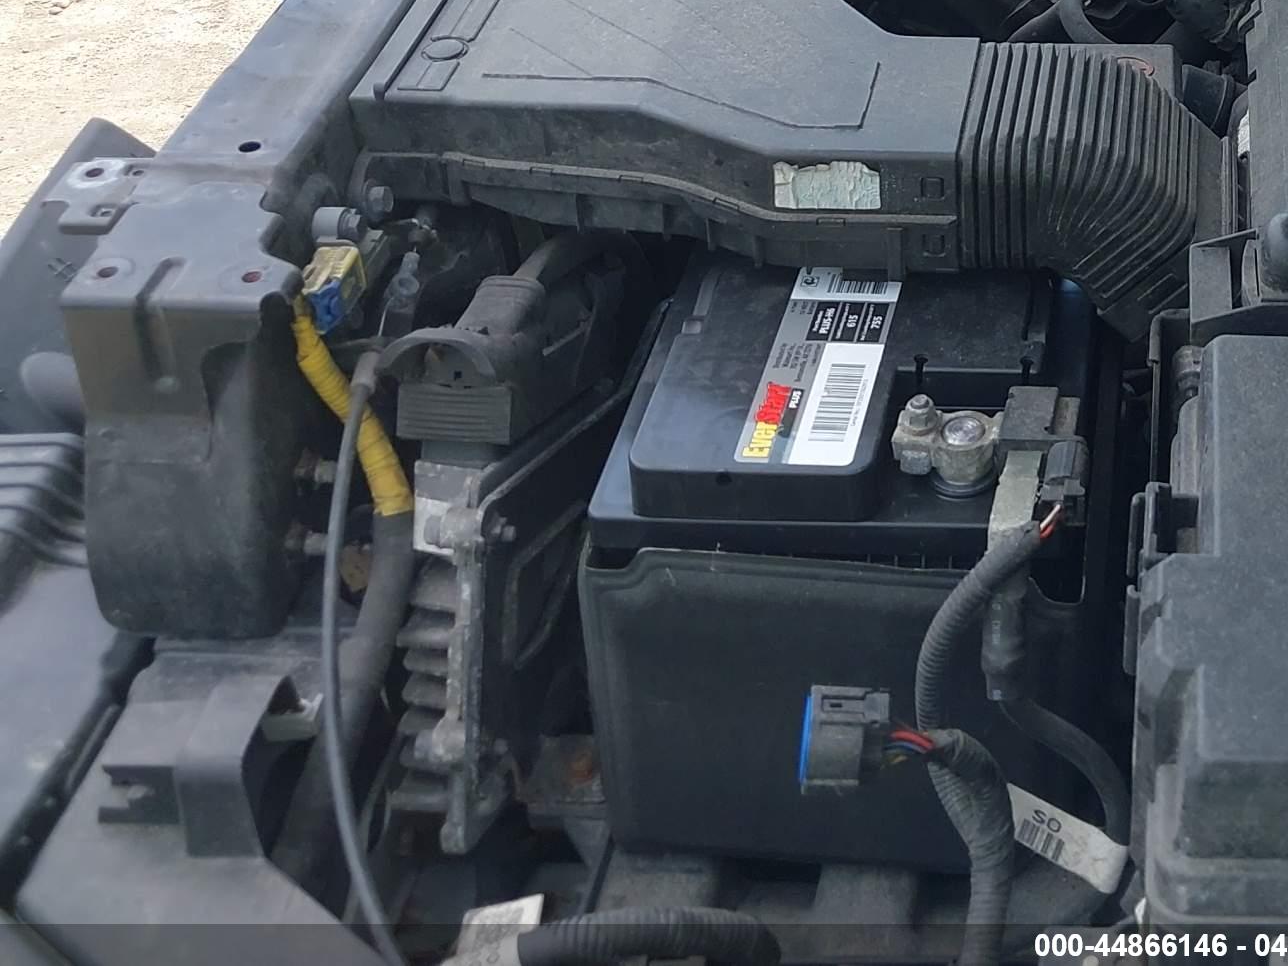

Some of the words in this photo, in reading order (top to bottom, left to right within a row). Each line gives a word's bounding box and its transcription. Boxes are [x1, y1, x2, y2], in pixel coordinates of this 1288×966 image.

[819, 307, 836, 334] PLUS-H6
[846, 314, 859, 328] 615
[870, 315, 883, 329] 755
[788, 390, 802, 409] PLUS
[742, 383, 791, 458] EverStart
